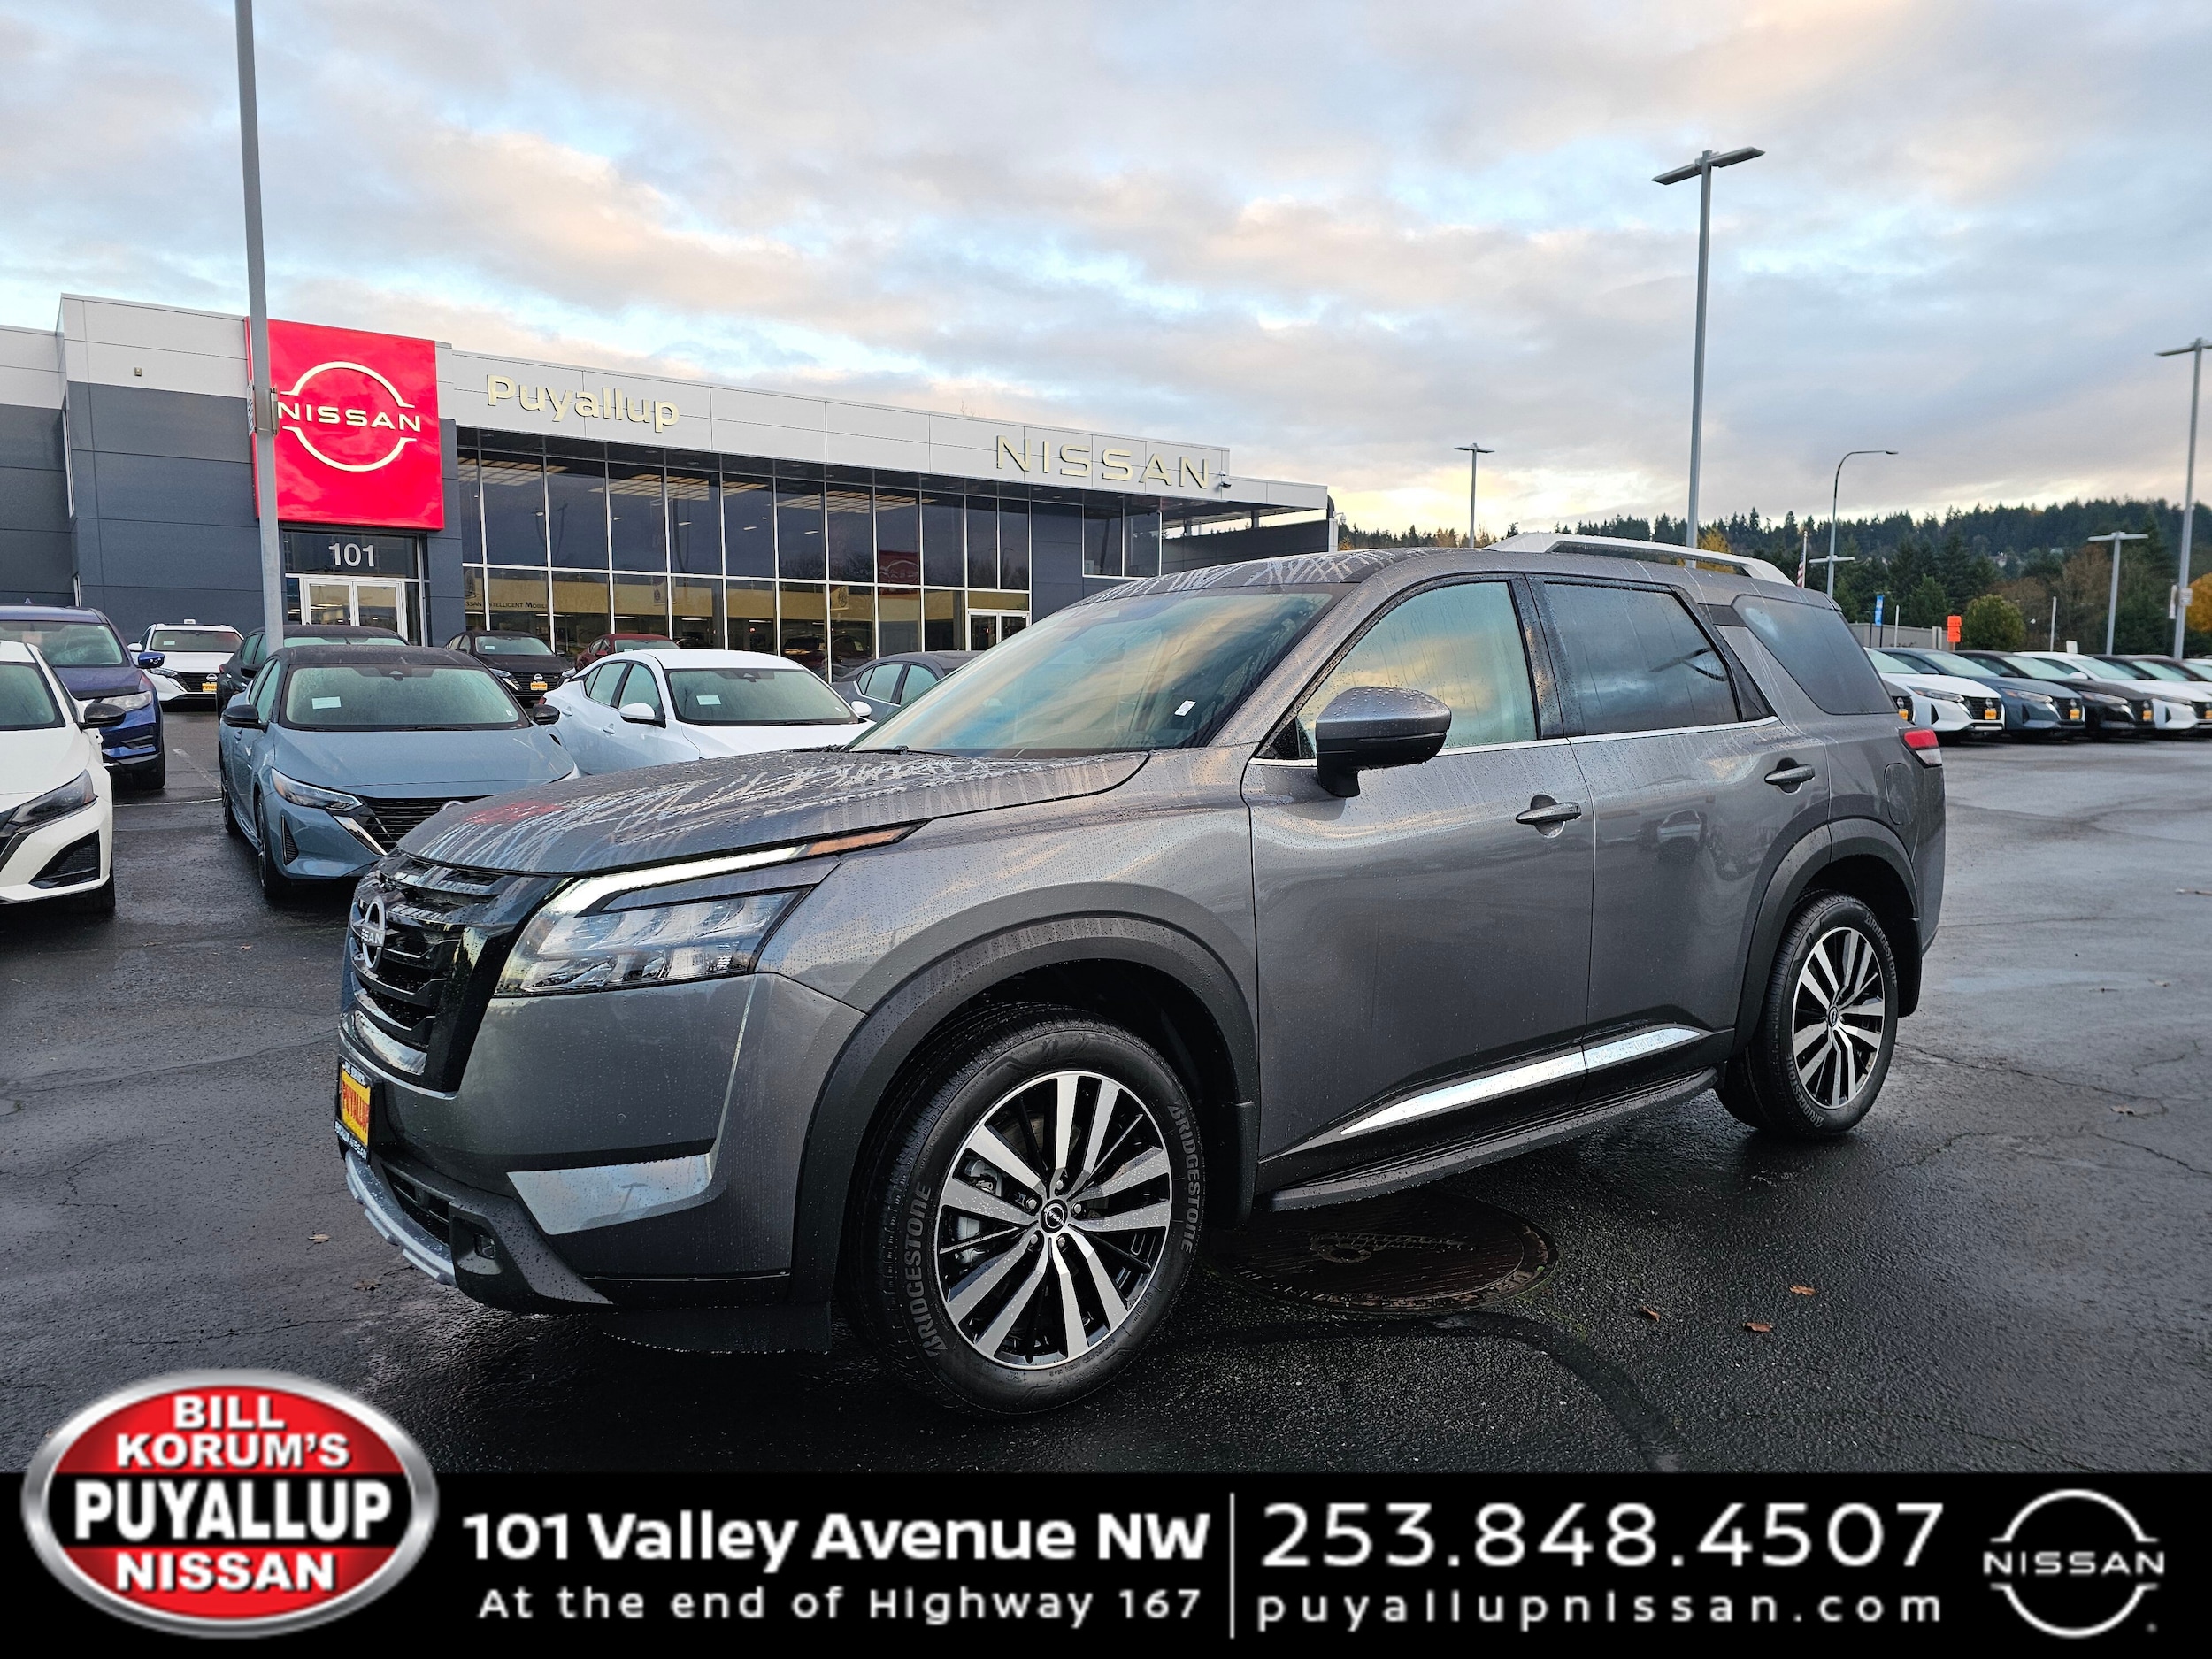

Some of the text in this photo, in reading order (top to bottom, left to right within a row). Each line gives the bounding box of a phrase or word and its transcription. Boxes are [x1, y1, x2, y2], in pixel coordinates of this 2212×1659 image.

[277, 401, 421, 432] NISSAN
[486, 373, 680, 434] Puyallup
[996, 434, 1209, 489] NISSAN
[328, 542, 375, 567] 101
[1168, 1101, 1201, 1255] BRIDGESTONE
[903, 1181, 948, 1358] BRIDGESTONE
